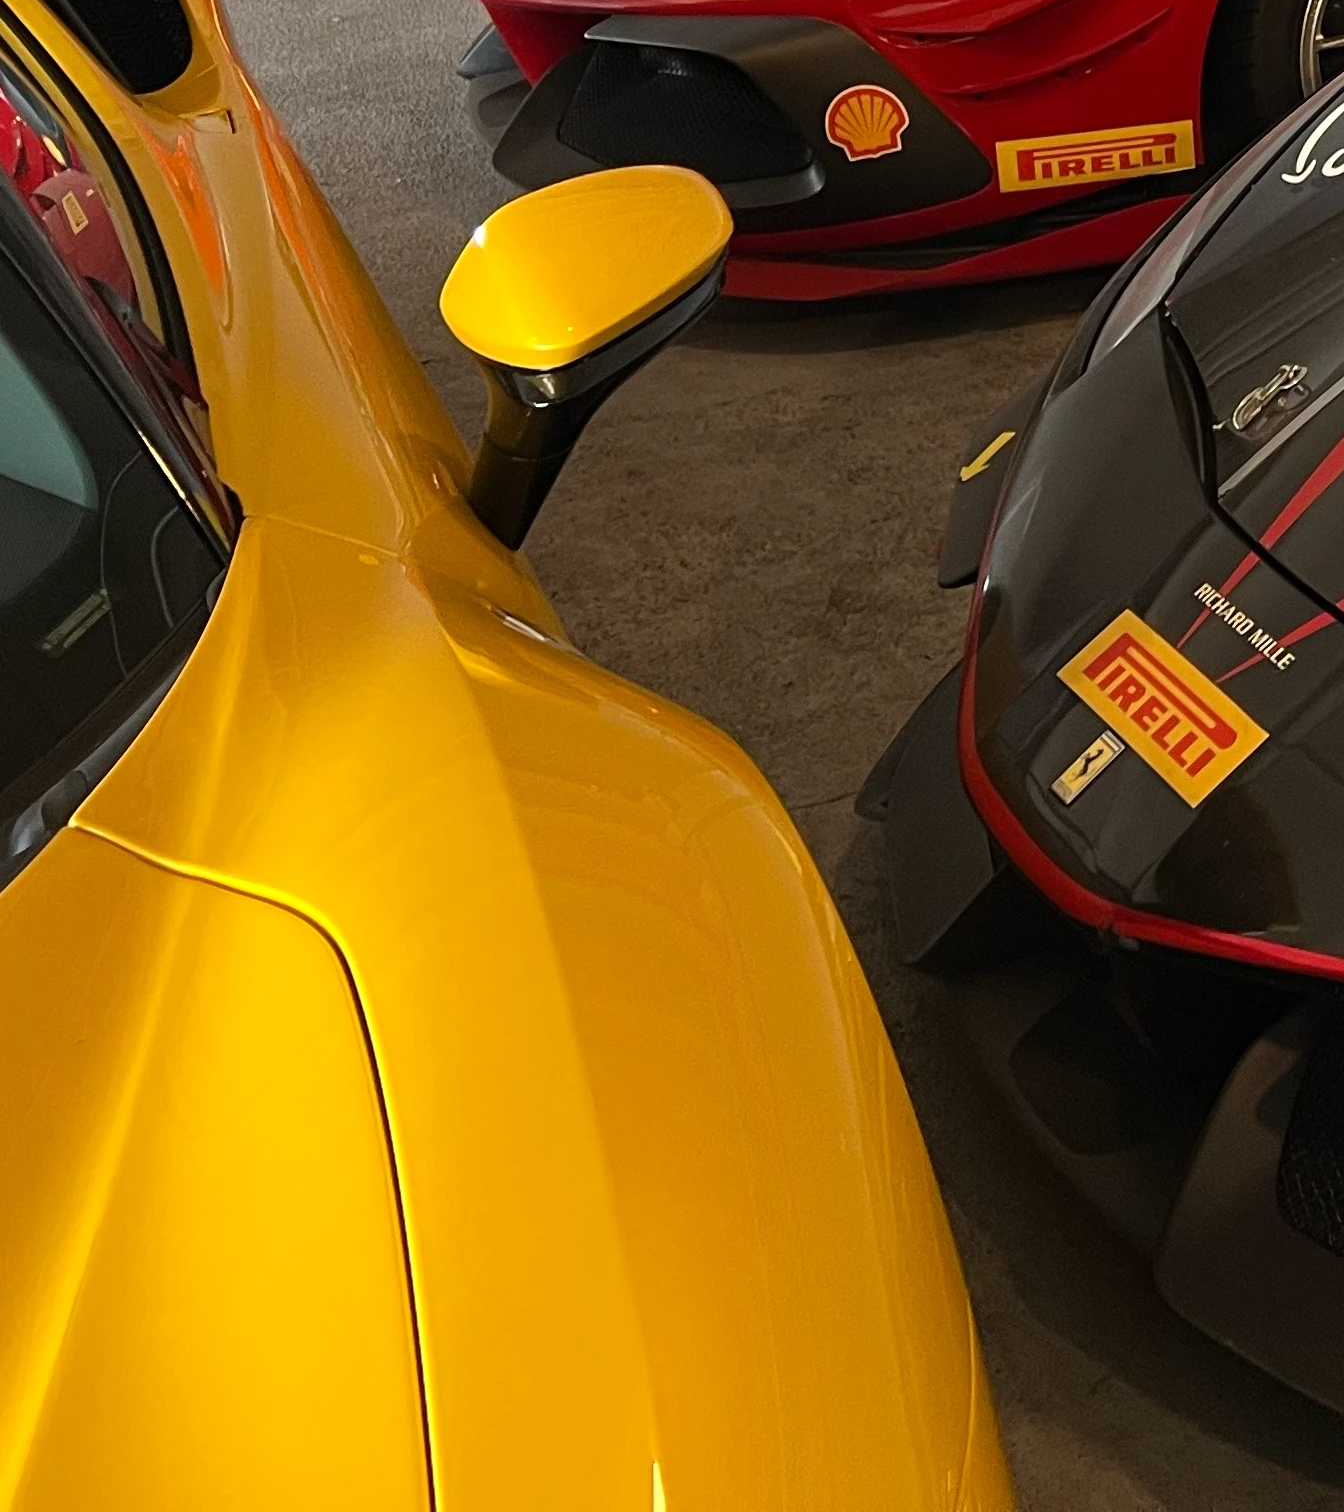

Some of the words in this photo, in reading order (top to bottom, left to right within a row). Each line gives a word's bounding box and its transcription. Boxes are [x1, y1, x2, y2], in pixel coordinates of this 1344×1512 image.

[1016, 131, 1178, 184] PIRELLI
[1193, 582, 1255, 636] RICHARD
[1247, 628, 1296, 671] MILLE
[1080, 630, 1239, 778] PIRELLI
